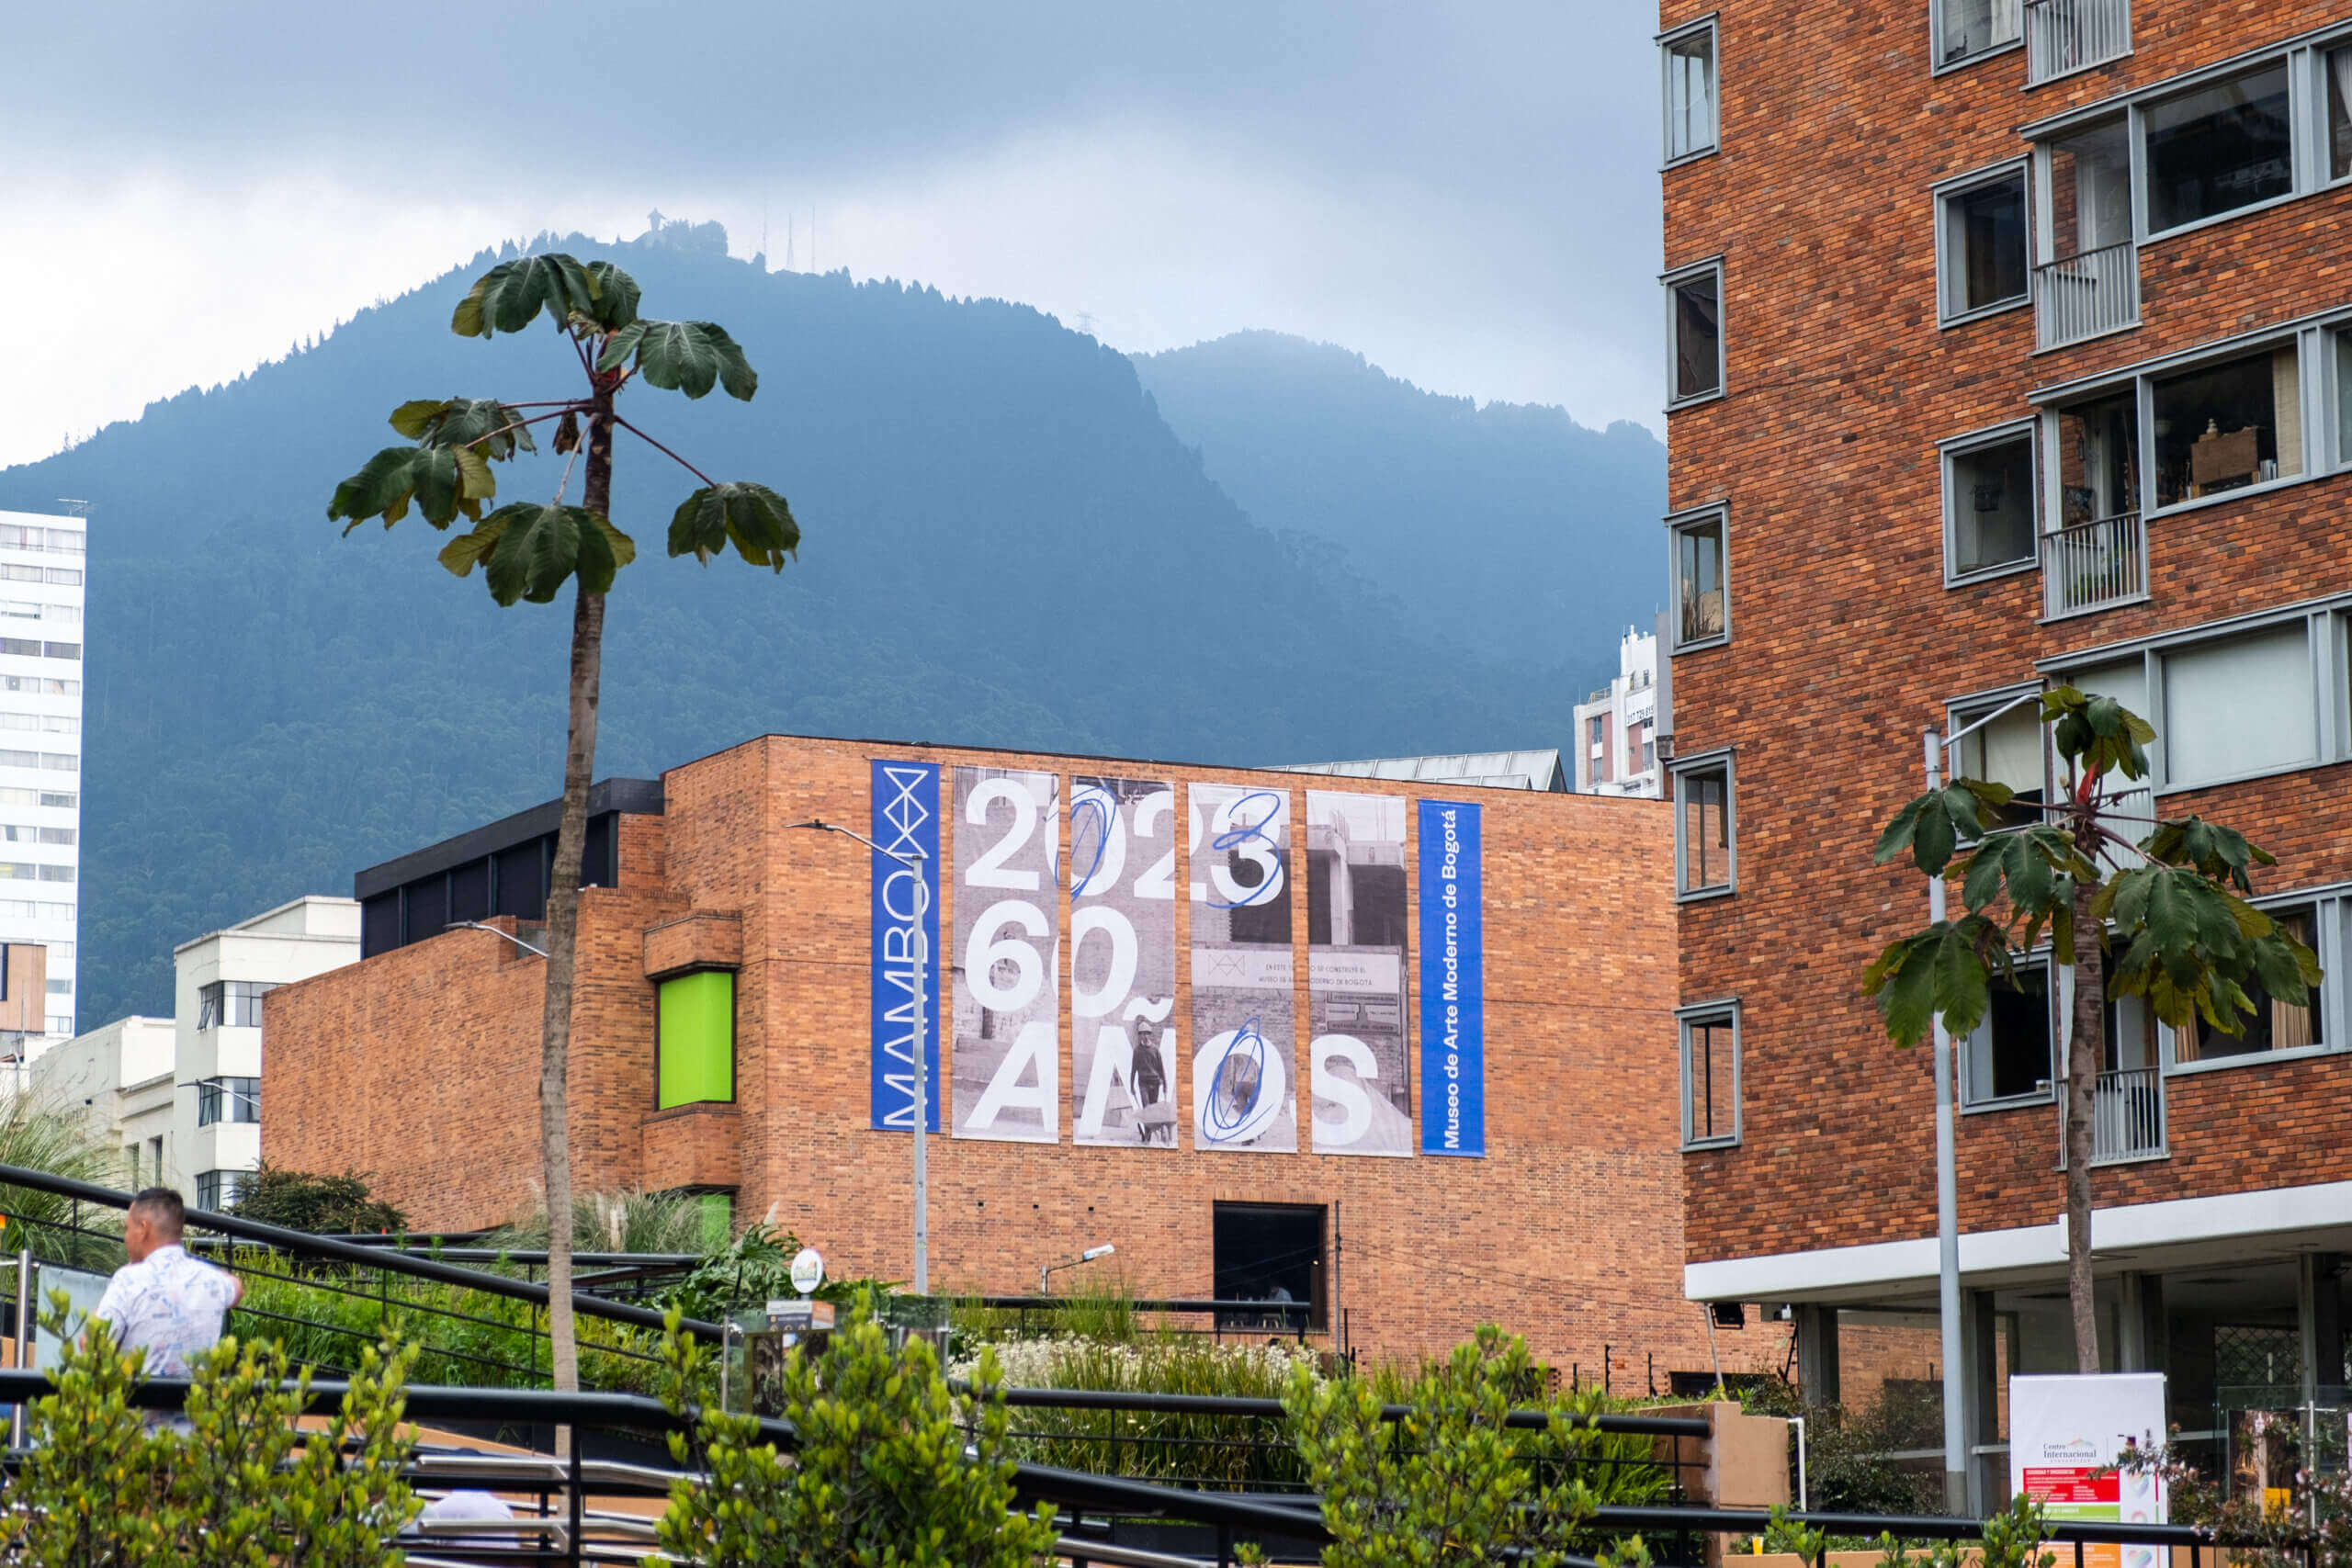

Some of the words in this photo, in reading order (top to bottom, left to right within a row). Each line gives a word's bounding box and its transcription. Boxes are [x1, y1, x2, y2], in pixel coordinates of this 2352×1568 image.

[965, 778, 1284, 906] 2023
[1441, 809, 1460, 879] Bogotá
[1442, 884, 1457, 908] de
[966, 899, 1138, 1018] 60
[1442, 912, 1458, 1001] Moderno
[882, 869, 930, 1127] MAMBO
[1442, 1005, 1459, 1050] Arte
[964, 997, 1378, 1146] AÑOS
[1443, 1054, 1459, 1079] de
[1443, 1082, 1460, 1149] Museo
[2042, 1449, 2097, 1459] Internacional
